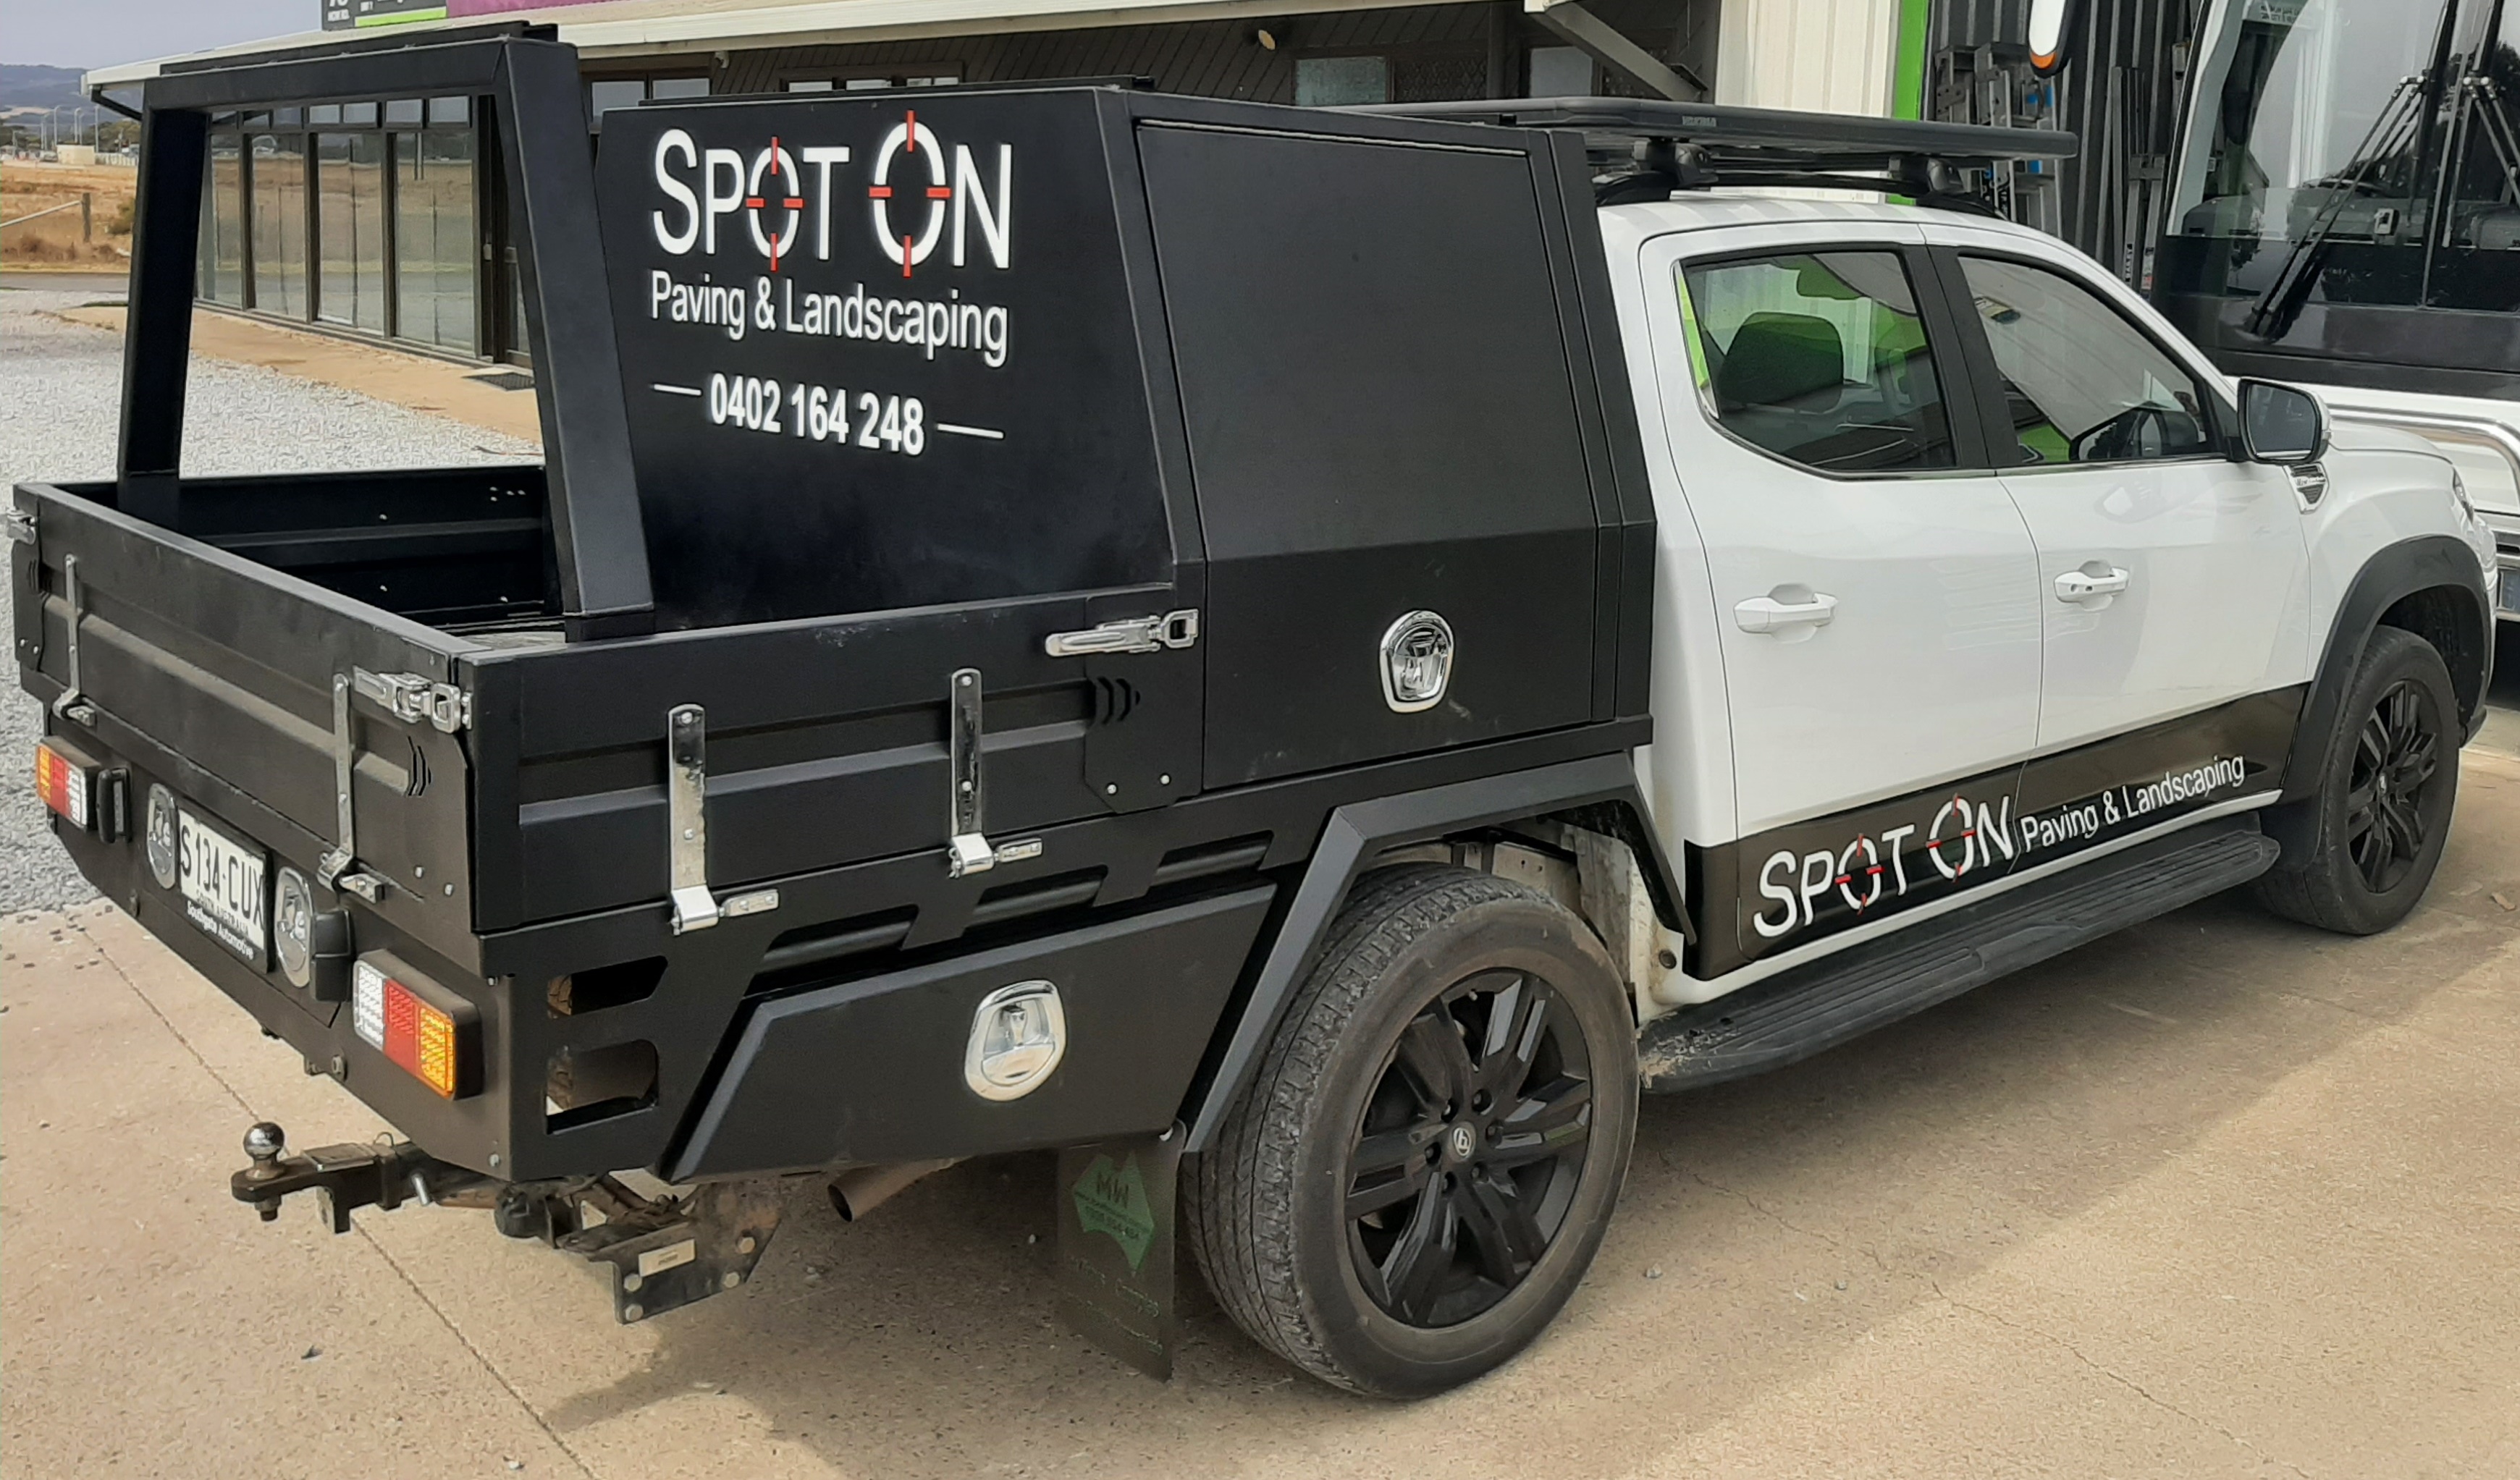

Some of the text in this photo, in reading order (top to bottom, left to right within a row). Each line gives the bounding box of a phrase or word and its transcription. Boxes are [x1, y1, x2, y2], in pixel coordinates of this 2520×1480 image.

[653, 110, 1012, 278] SPOT ON
[652, 270, 1008, 368] Paving & Landscaping
[710, 373, 924, 457] 0402 164 248
[2020, 753, 2245, 854] Paving & Landscaping
[1753, 795, 2015, 937] SPOT ON
